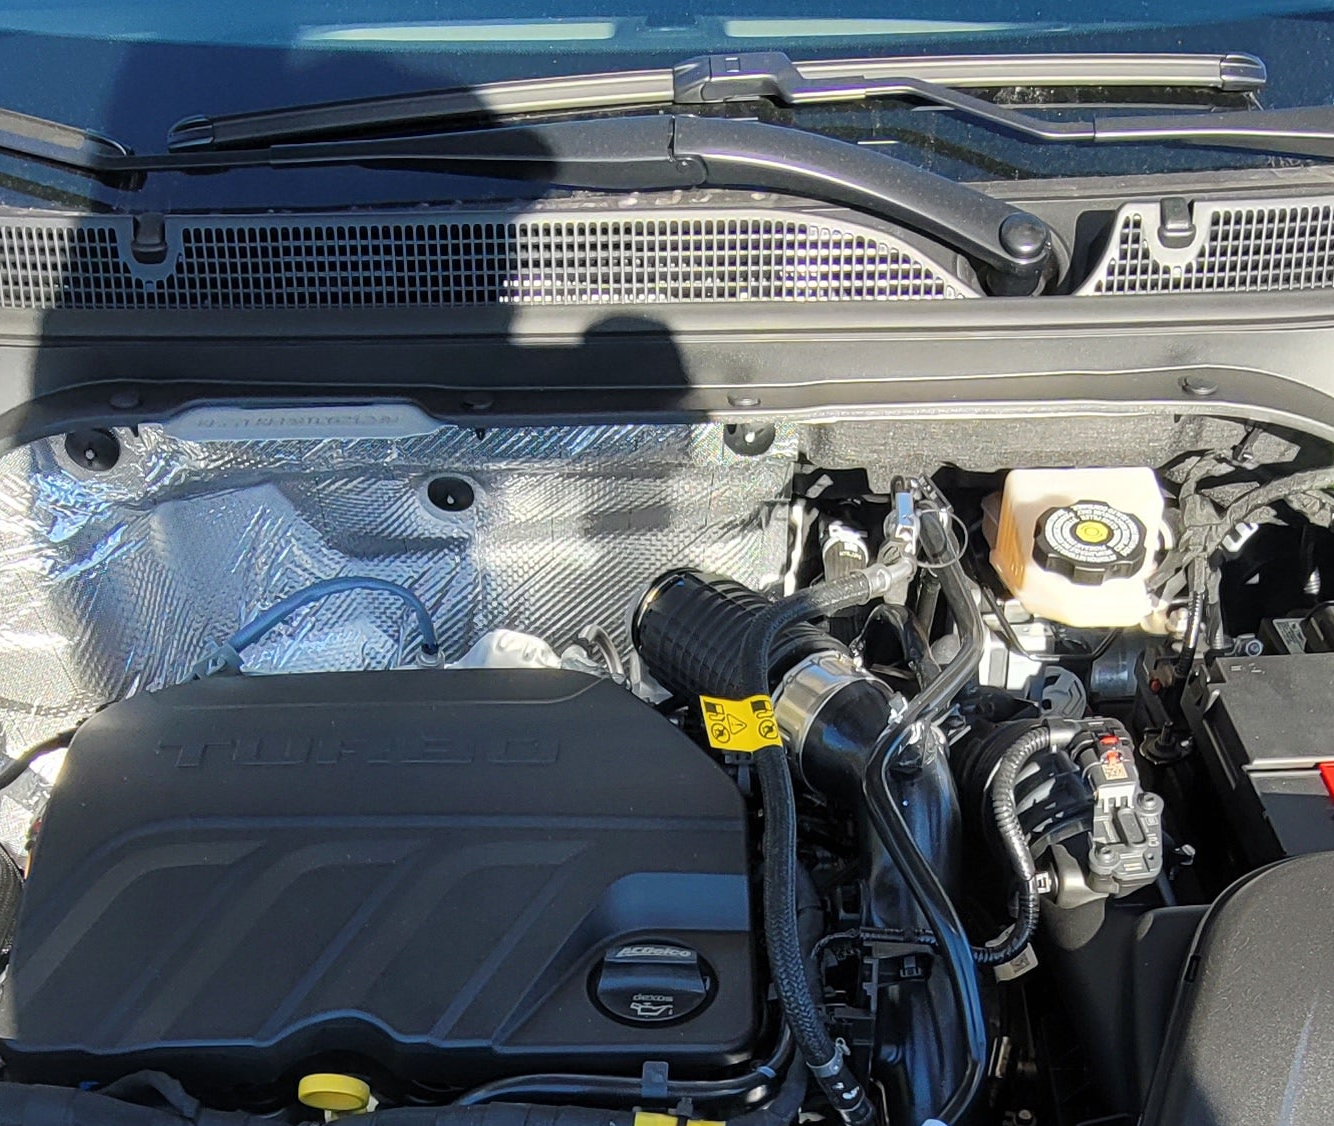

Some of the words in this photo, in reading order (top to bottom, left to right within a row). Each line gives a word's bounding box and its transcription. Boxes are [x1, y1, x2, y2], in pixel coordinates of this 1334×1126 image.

[160, 737, 560, 768] TURBO
[615, 946, 691, 957] ACDelco
[632, 993, 673, 1002] dexos
